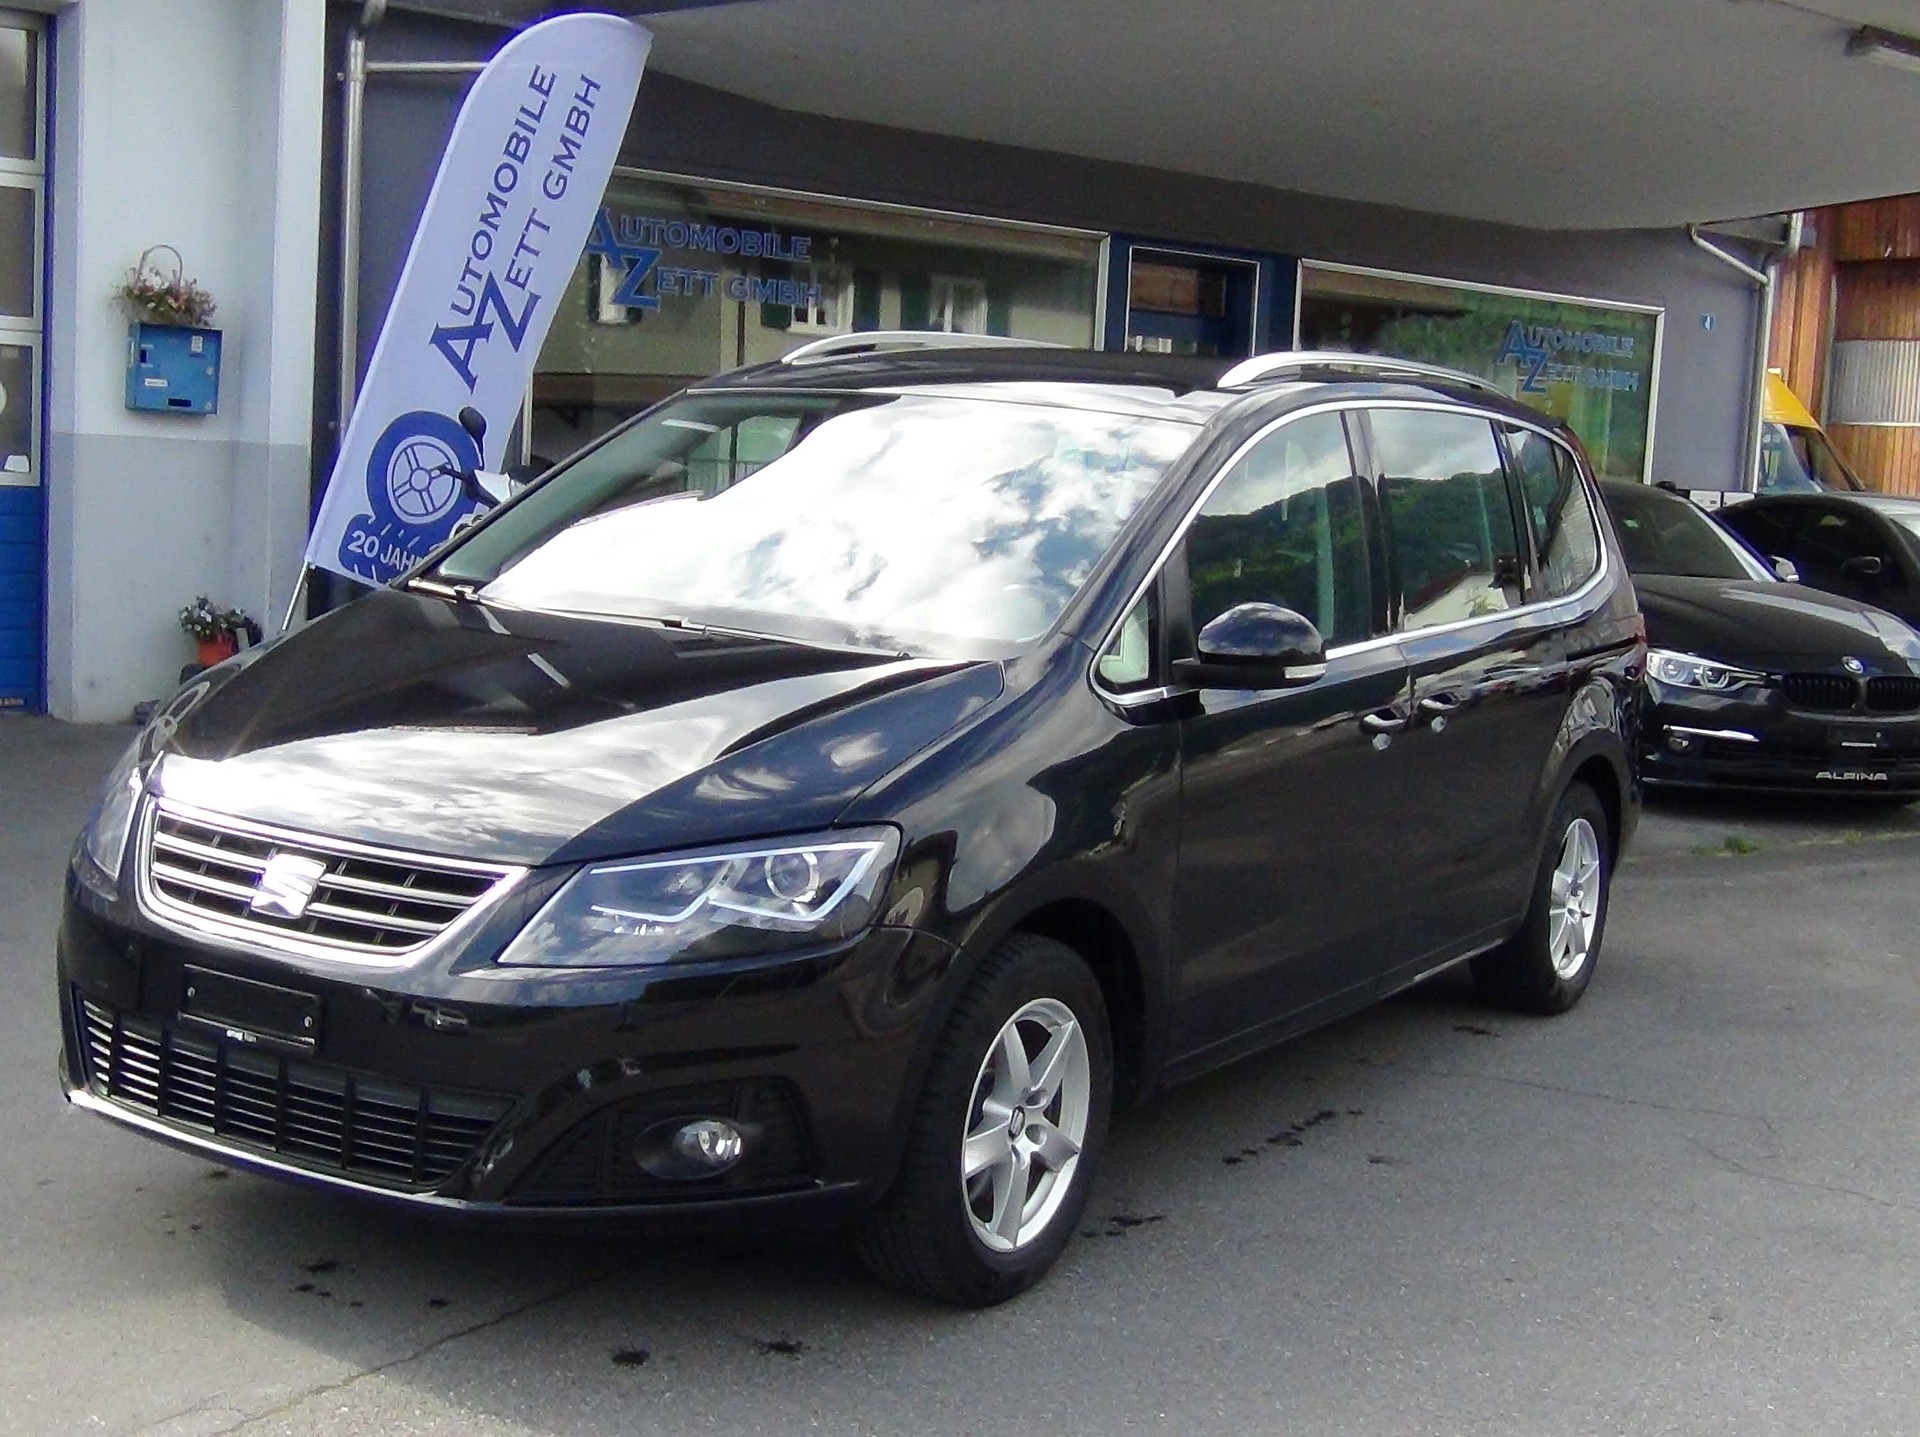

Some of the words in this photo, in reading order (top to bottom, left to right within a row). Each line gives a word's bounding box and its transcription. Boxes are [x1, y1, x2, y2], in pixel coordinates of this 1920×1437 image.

[430, 63, 556, 395] AUTOMOBILE
[474, 207, 551, 353] ZETT
[543, 74, 601, 200] GMBH
[587, 207, 812, 269] AUTOMOBILE
[613, 247, 719, 312] ZETT
[728, 274, 822, 308] GMBH
[347, 530, 380, 558] 20
[380, 544, 423, 571] JAH
[1815, 771, 1888, 781] ALPINA
